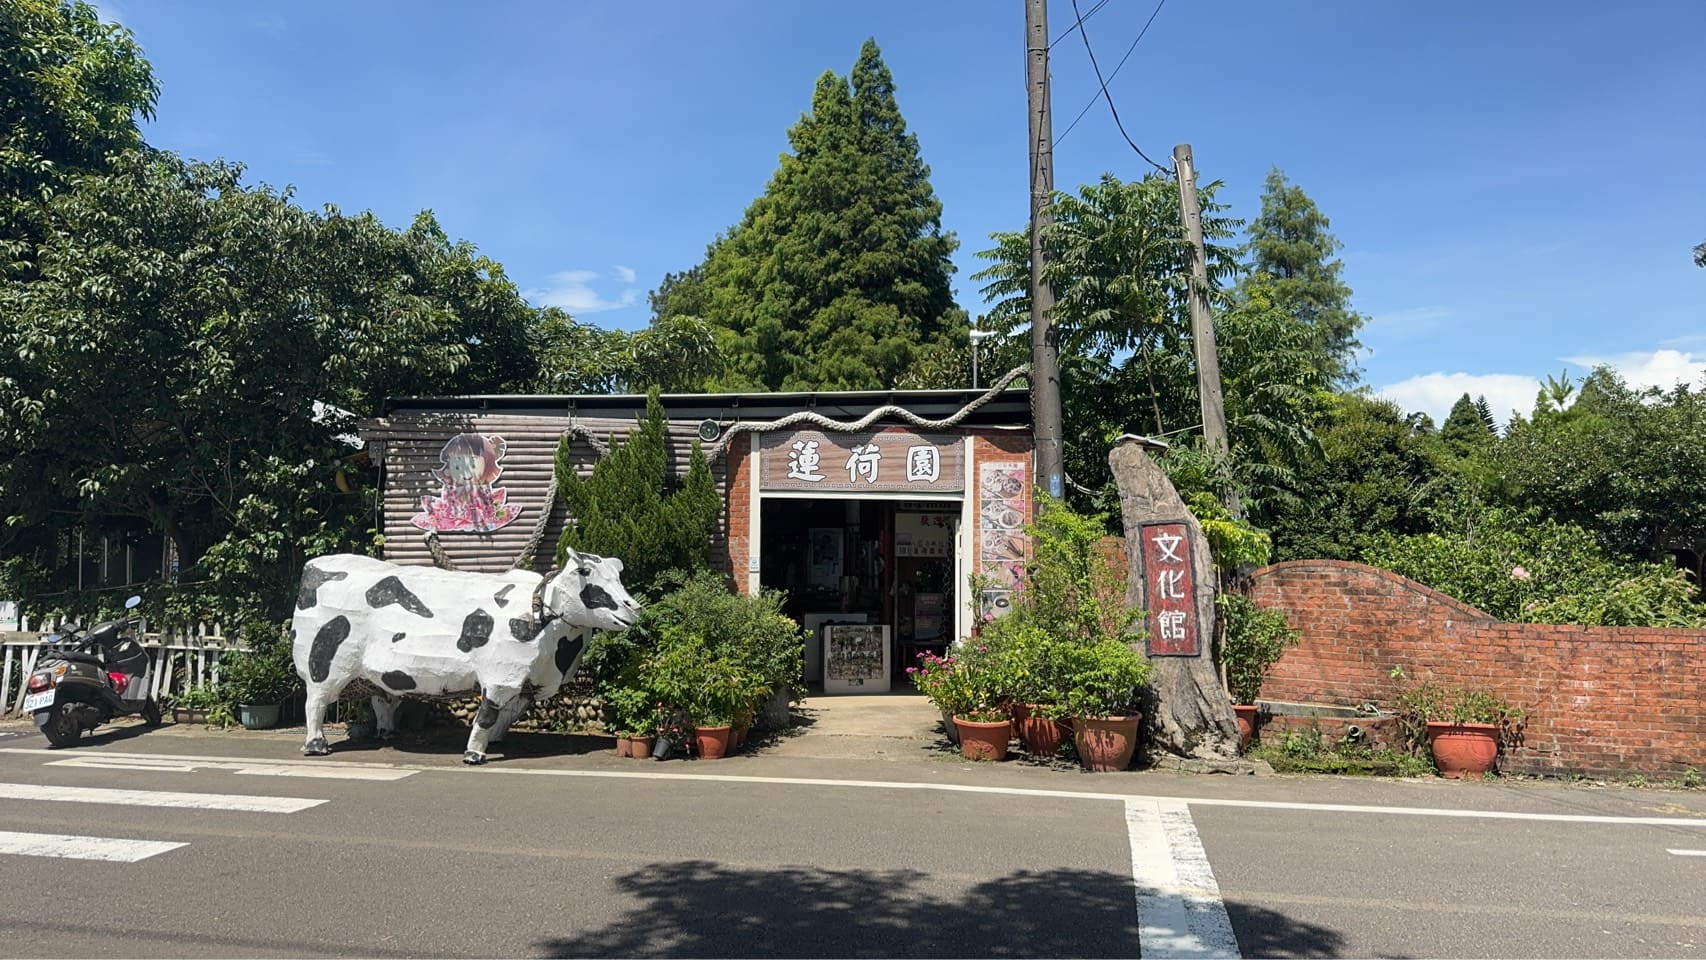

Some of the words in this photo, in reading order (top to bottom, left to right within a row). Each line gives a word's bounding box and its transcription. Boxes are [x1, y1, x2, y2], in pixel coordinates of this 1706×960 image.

[786, 440, 941, 484] 蓮荷園
[1151, 532, 1187, 641] 文化館
